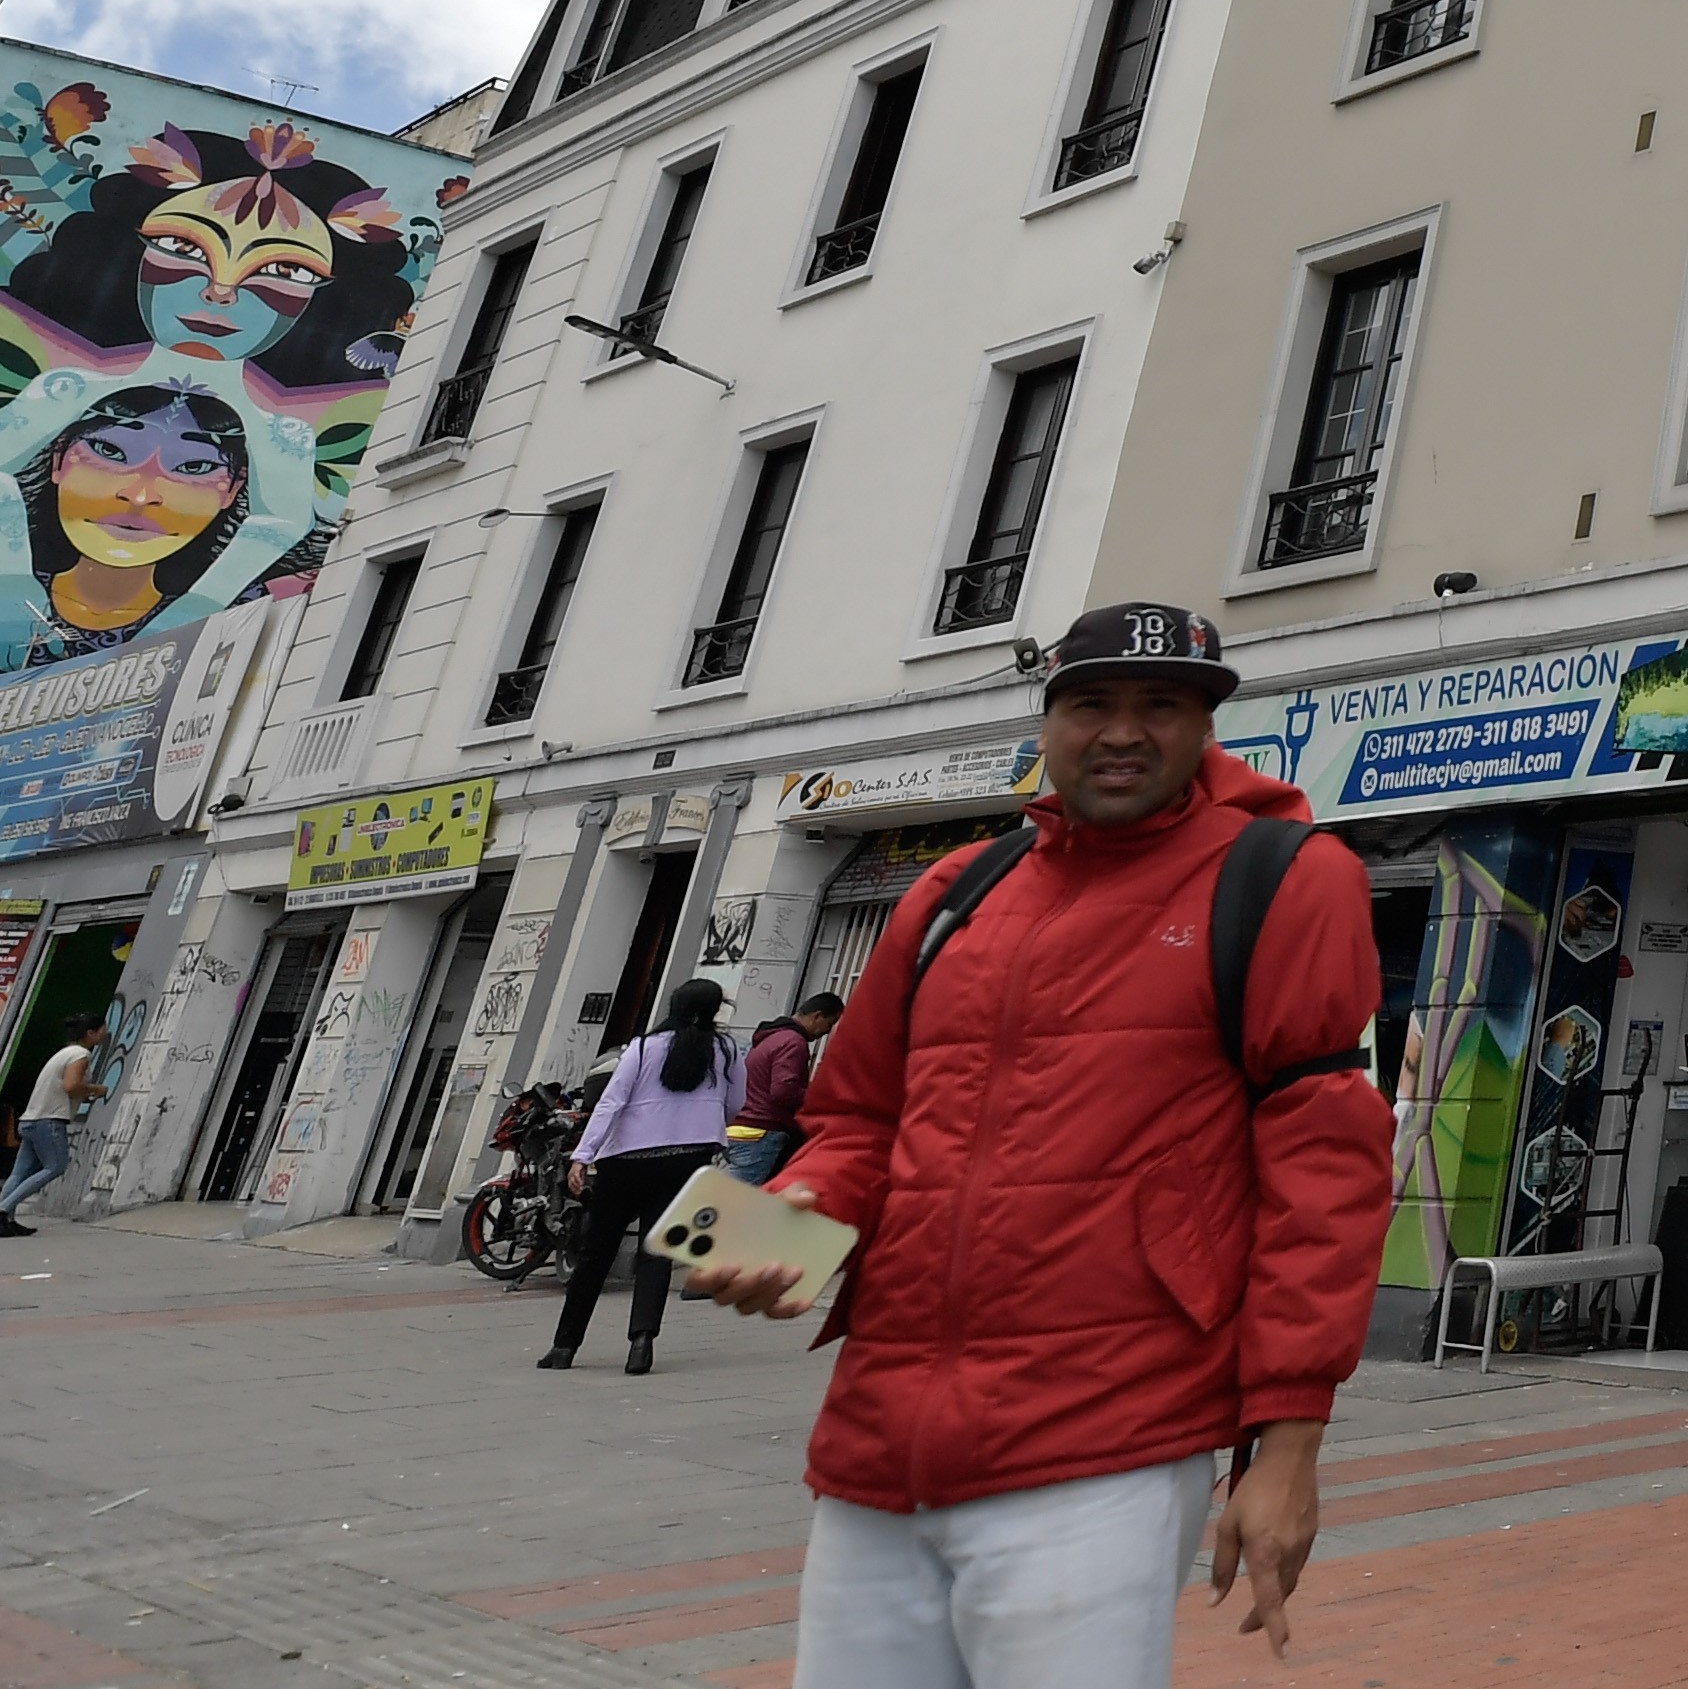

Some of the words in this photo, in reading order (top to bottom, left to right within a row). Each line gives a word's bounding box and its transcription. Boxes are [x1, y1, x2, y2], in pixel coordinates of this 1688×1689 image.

[1330, 683, 1408, 725] VENTA
[1418, 678, 1433, 712] Y
[1439, 646, 1619, 709] REPARACIÓN
[1381, 736, 1403, 759] 311
[1406, 730, 1433, 755] 472
[1436, 721, 1507, 752] 2779-311
[1511, 716, 1541, 741] 818
[1544, 709, 1589, 739] 3491
[1379, 750, 1562, 791] multitecjv@gmail.com
